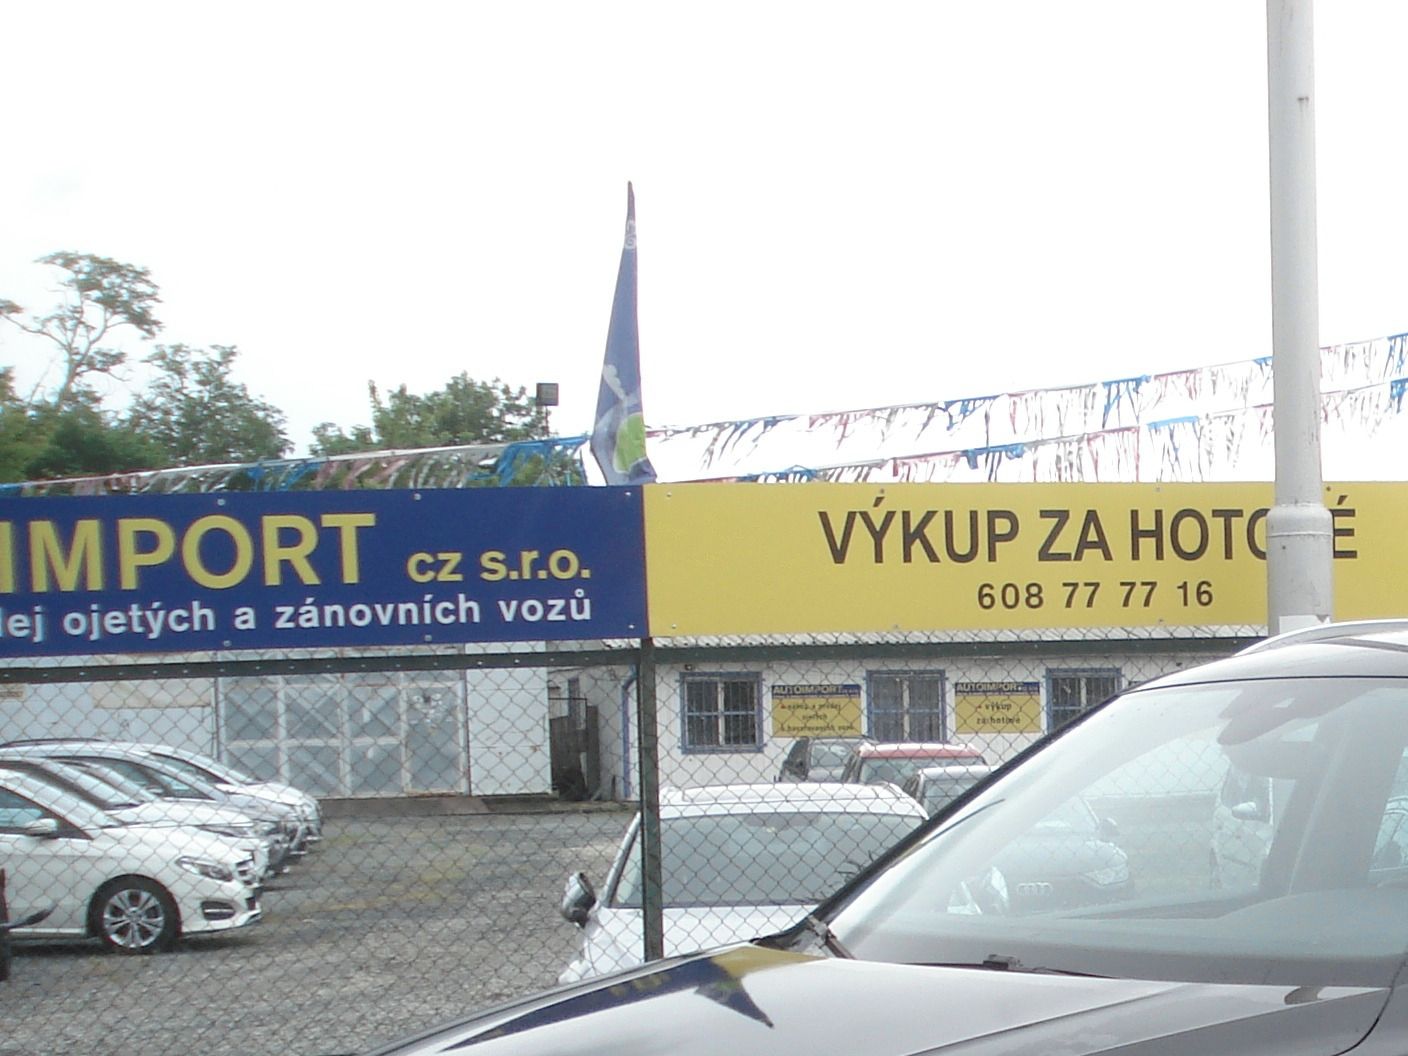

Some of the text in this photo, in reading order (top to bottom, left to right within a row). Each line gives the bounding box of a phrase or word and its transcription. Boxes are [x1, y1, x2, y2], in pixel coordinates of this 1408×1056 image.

[818, 496, 1020, 564] VÝKUP
[1037, 509, 1113, 562] ZA
[407, 552, 463, 582] cz
[480, 549, 591, 580] s.r.o.
[0, 588, 591, 642] ej ojetých a zánovních vozů
[977, 580, 1213, 609] 608 77 77 16
